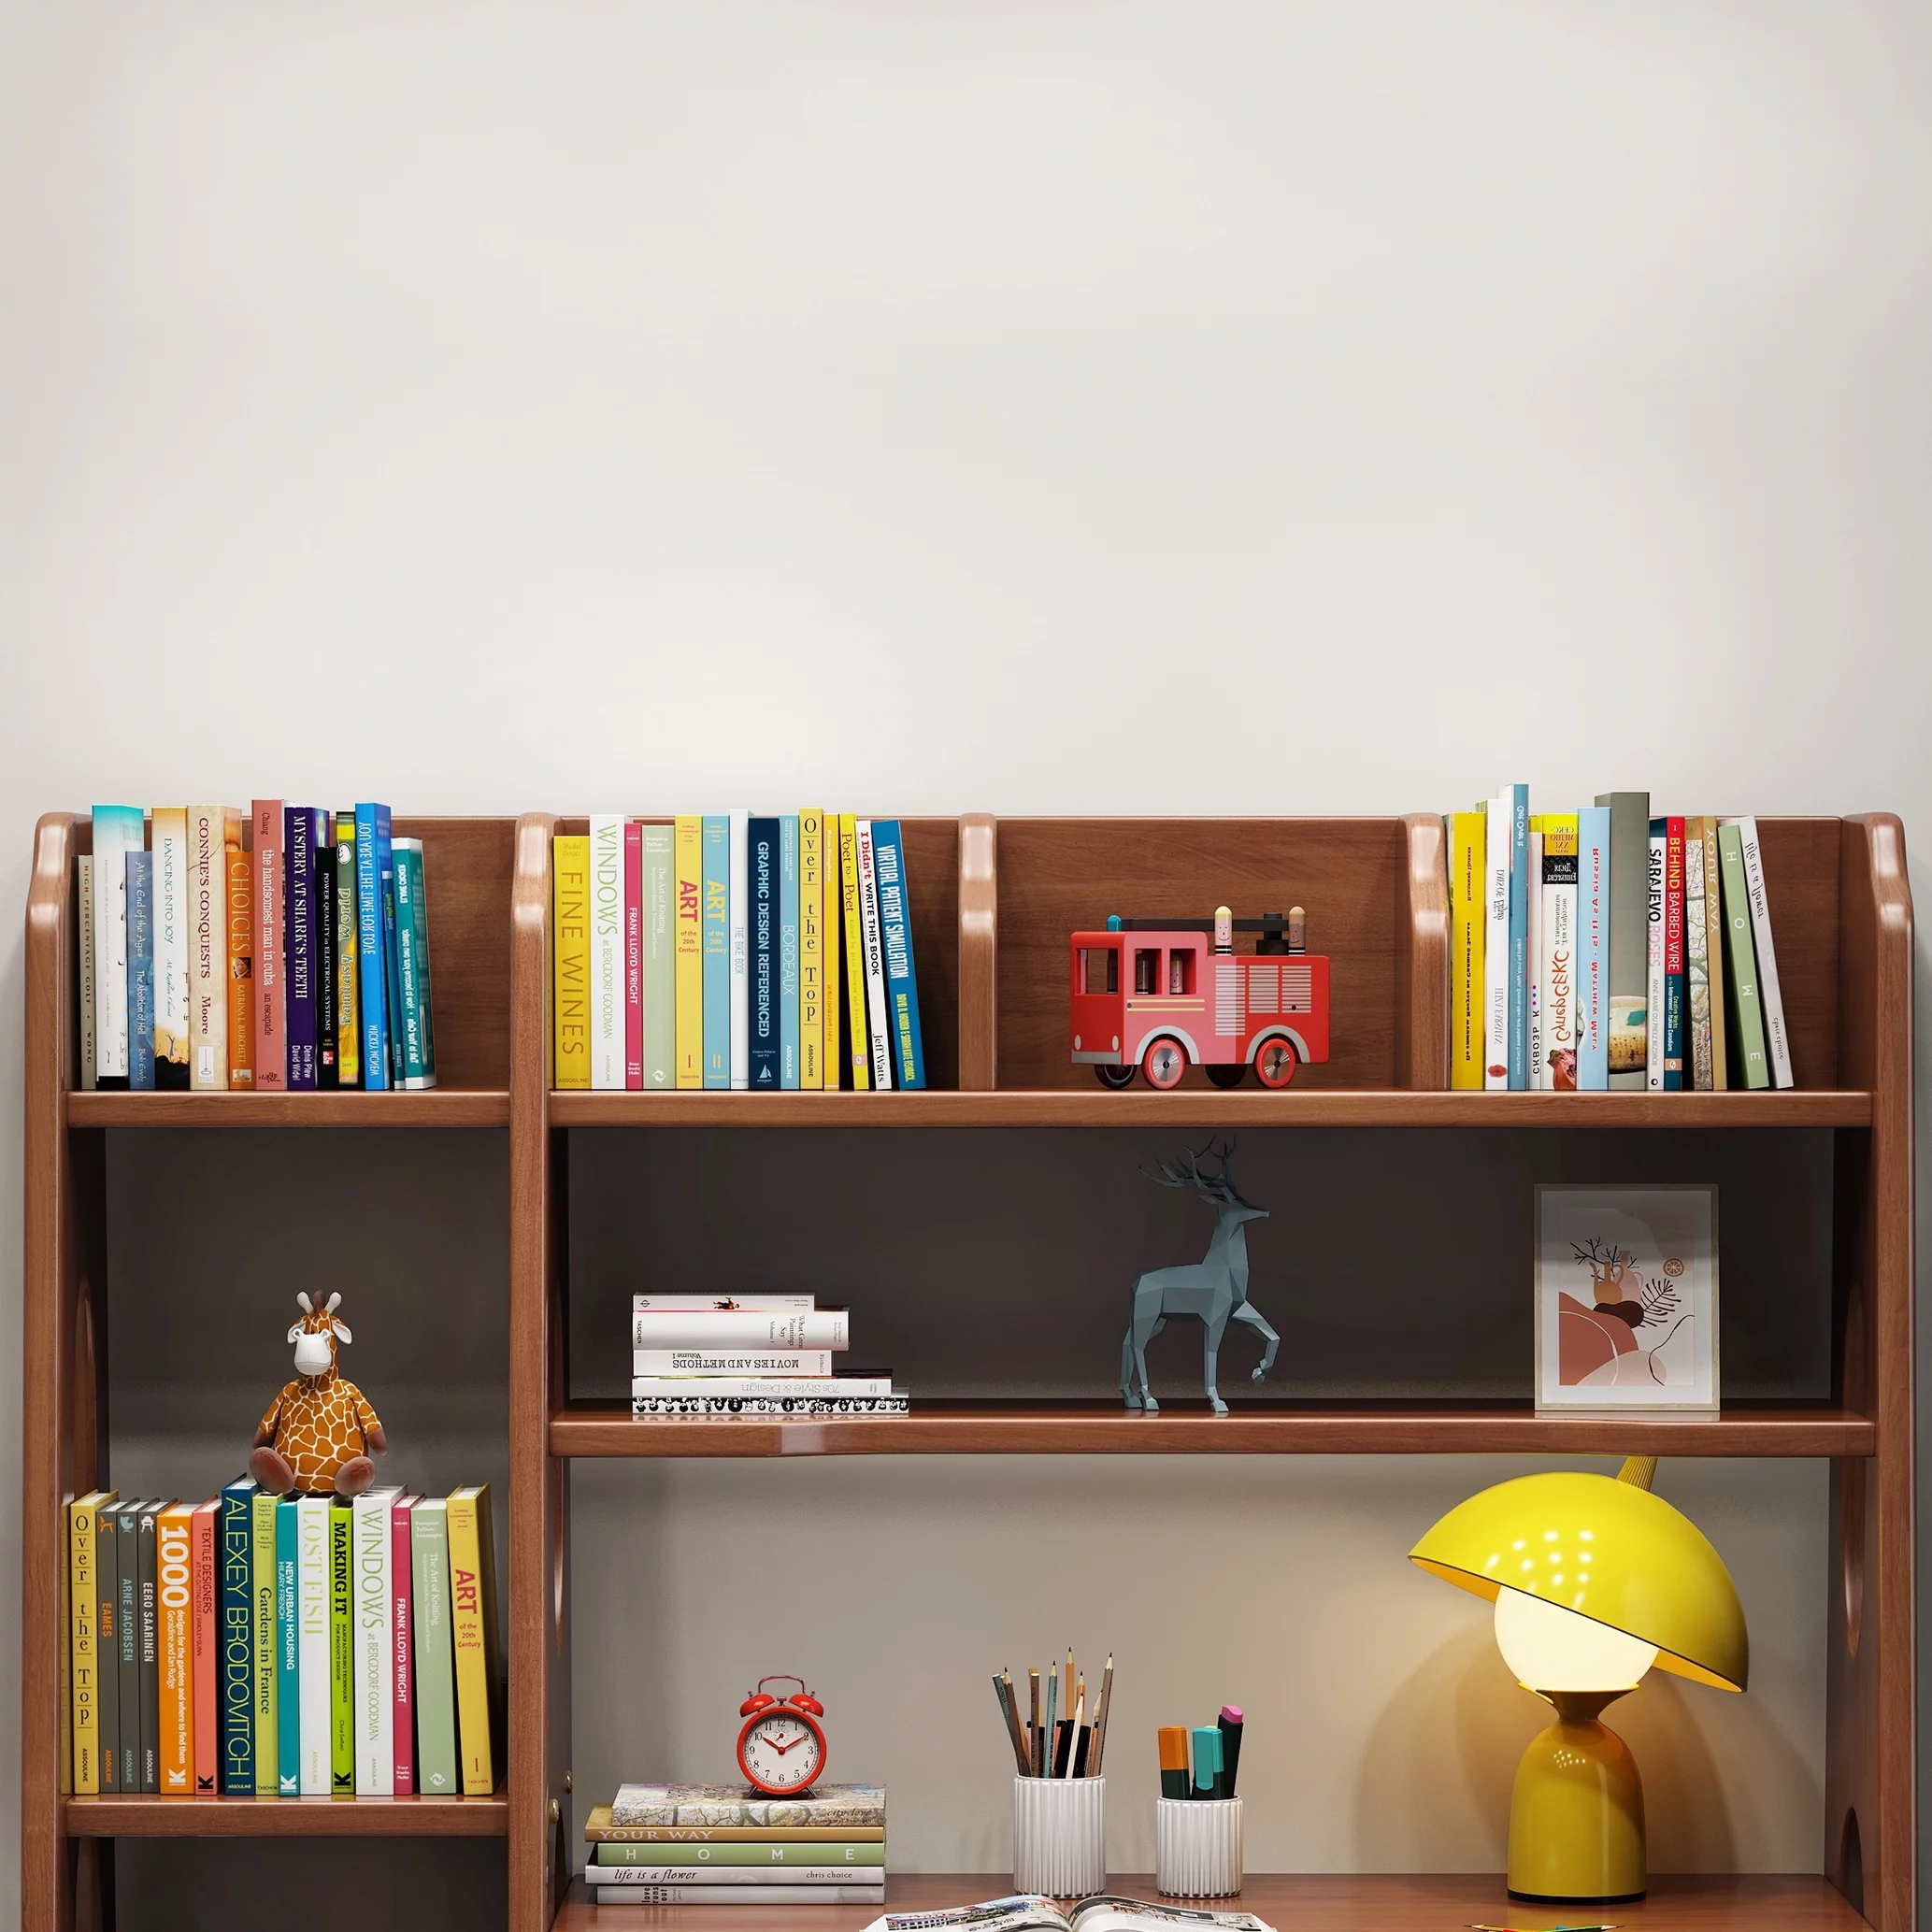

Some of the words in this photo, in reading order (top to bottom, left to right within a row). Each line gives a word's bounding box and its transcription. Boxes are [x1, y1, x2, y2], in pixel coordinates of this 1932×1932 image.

[260, 812, 270, 835] Chiang
[165, 838, 173, 892] DANCING
[198, 817, 209, 886] CONNIE'S
[263, 850, 274, 866] the
[293, 816, 307, 876] MYSTERY
[842, 833, 852, 862] Poet
[877, 845, 899, 885] VIRTUAL
[1669, 837, 1681, 888] BEHIND
[597, 824, 617, 935] WINDOWS
[757, 841, 769, 899] GRAPHIC
[1649, 849, 1662, 923] SARAJEVO
[165, 894, 173, 921] INTO
[231, 862, 250, 951] CHOICES
[263, 867, 275, 924] handsomest
[338, 888, 351, 941] World
[562, 872, 582, 938] FINE
[680, 880, 697, 923] ART
[707, 880, 725, 923] ART
[881, 887, 903, 923] PATIENT
[1668, 892, 1680, 938] BARBED
[165, 923, 173, 944] JOY
[198, 890, 210, 979] CONQUESTS
[264, 927, 273, 948] man
[294, 899, 307, 954] SHARK'S
[657, 905, 665, 933] Knitting
[735, 926, 743, 938] THE
[758, 903, 769, 950] DESIGN
[868, 919, 877, 942] THIS
[735, 941, 743, 955] BIKE
[782, 925, 794, 995] BORDEAUX
[885, 924, 909, 979] SIMULATION
[1668, 941, 1680, 970] WIRE
[264, 964, 276, 986] cuba
[295, 958, 308, 998] TEETH
[339, 954, 353, 1025] Fantasy
[603, 948, 612, 993] BERGDORF
[136, 983, 145, 1012] Abolition
[202, 996, 211, 1035] Moore
[237, 984, 246, 1017] KATRINA
[562, 954, 583, 1054] WINES
[603, 994, 613, 1038] GOODMAN
[758, 954, 769, 1038] REFERENCED
[263, 1004, 274, 1035] escapade
[237, 1024, 246, 1063] BURCHETT
[292, 1045, 300, 1062] David
[304, 1045, 312, 1062] Denis
[672, 1359, 727, 1368] METHODS
[728, 1359, 751, 1368] AND
[754, 1359, 799, 1368] MOVIES
[741, 1383, 780, 1394] Design
[794, 1383, 821, 1394] Style
[823, 1384, 840, 1394] 70s
[225, 1497, 248, 1598] ALEXEY
[303, 1510, 323, 1573] LOST
[335, 1522, 347, 1593] MAKING
[161, 1525, 189, 1608] 1000
[362, 1508, 384, 1629] WINDOWS
[122, 1579, 132, 1605] ARNE
[203, 1565, 211, 1614] DESIGNERS
[455, 1568, 477, 1614] ART
[102, 1603, 112, 1638] EAMES
[123, 1610, 133, 1661] JACOBSEN
[260, 1587, 272, 1645] Gardens
[144, 1611, 153, 1662] SAARINEN
[286, 1624, 294, 1669] HOUSING
[226, 1608, 250, 1775] BRODOVITCH
[261, 1667, 273, 1714] France
[754, 1732, 763, 1740] 10
[765, 1722, 772, 1731] 11
[778, 1718, 786, 1727] 12
[808, 1746, 814, 1754] 3
[779, 1774, 785, 1782] 6
[598, 1831, 660, 1839] YOUR
[667, 1831, 713, 1839] WAY
[625, 1849, 855, 1861] HOME
[614, 1868, 633, 1881] life
[637, 1869, 647, 1880] is
[661, 1869, 697, 1882] flower
[642, 1887, 651, 1903] love
